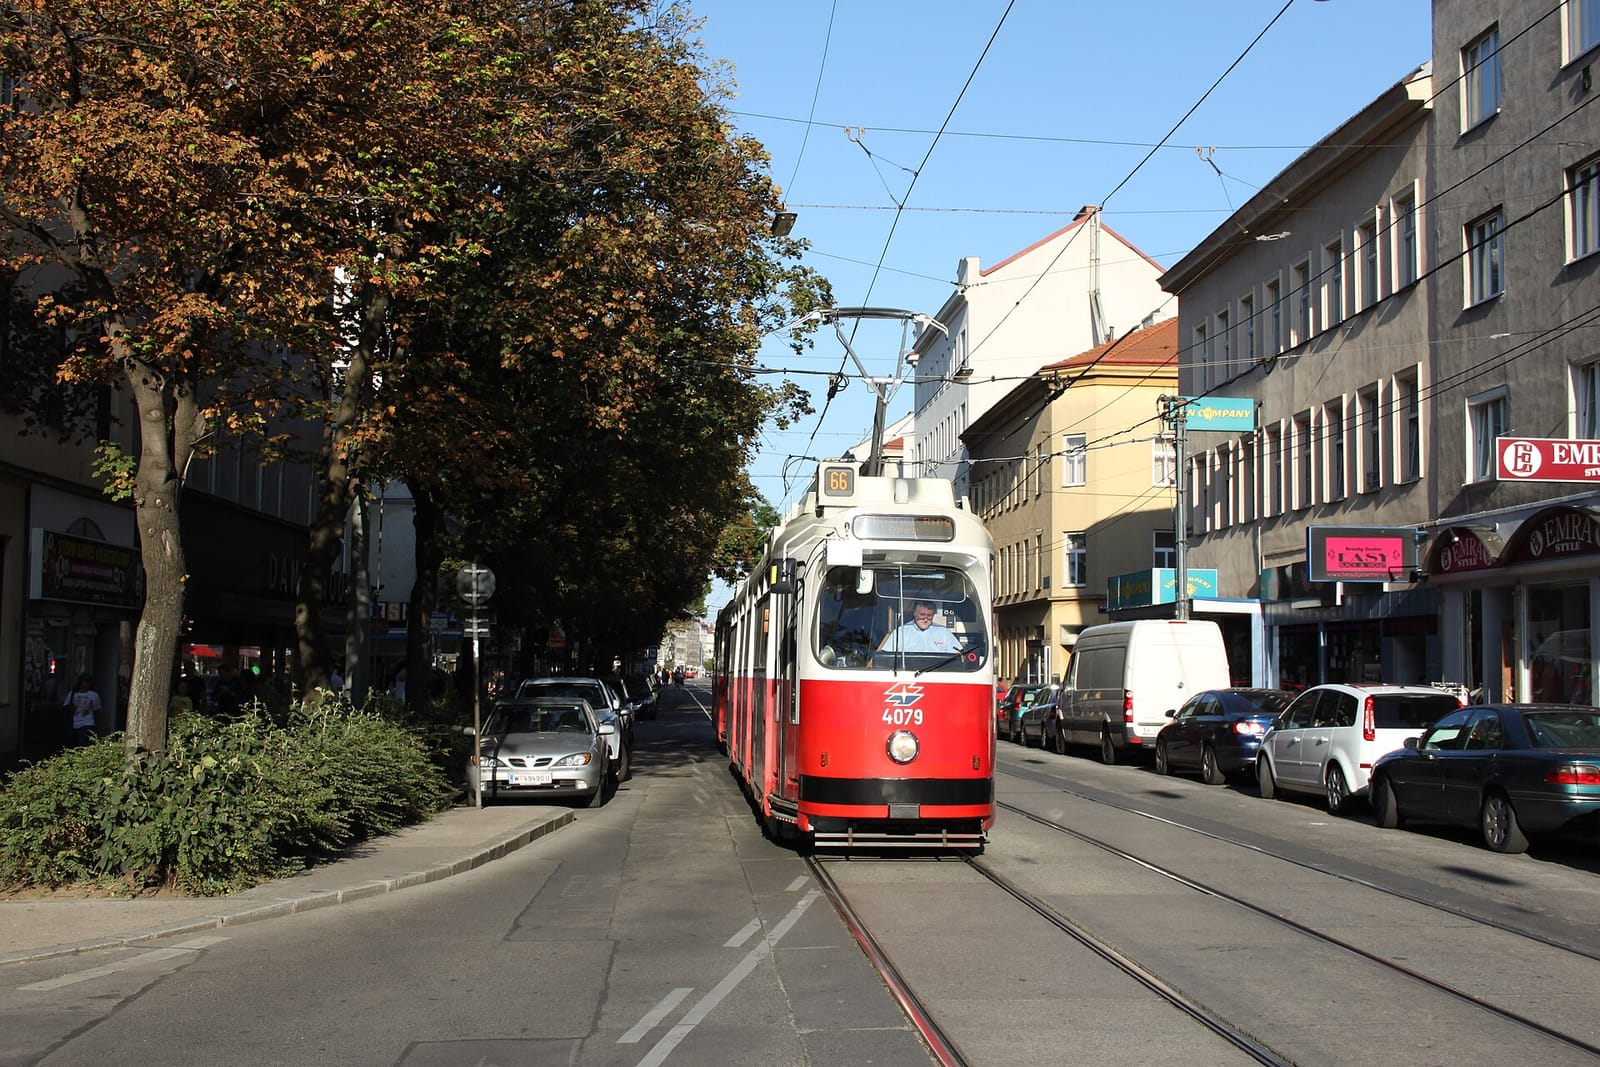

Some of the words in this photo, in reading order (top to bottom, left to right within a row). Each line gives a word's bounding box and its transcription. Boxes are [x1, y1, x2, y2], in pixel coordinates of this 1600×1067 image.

[829, 471, 848, 490] 66
[1544, 513, 1592, 548] EMRA
[1451, 537, 1483, 563] EMRA
[1554, 541, 1581, 553] STYLE
[1457, 558, 1478, 568] STYLE
[882, 708, 924, 726] 4079
